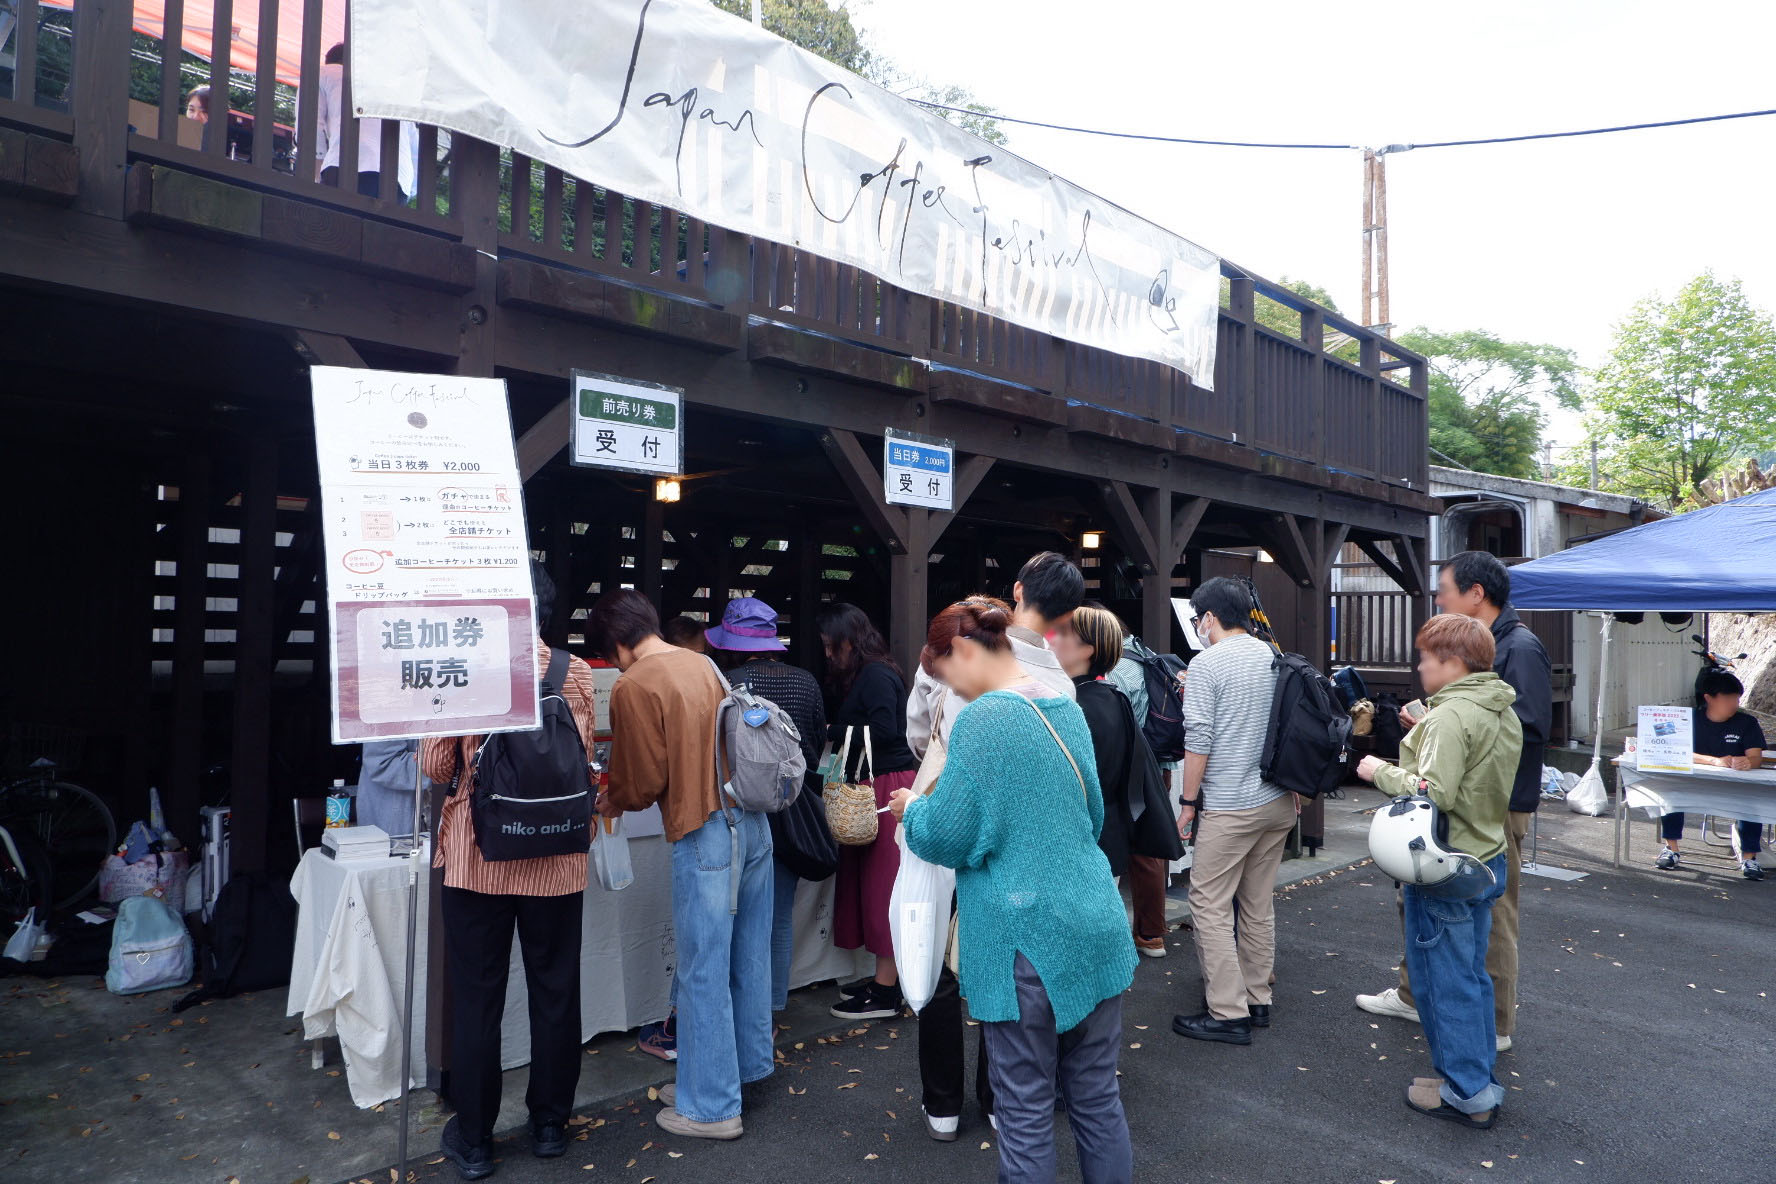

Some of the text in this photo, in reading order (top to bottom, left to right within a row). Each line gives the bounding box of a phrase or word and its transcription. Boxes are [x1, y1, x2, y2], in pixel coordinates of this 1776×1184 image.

[537, 0, 1120, 330] Japan Coffee Festival
[602, 397, 657, 420] 前売り券
[595, 429, 661, 460] 受付
[443, 461, 481, 472] ¥2,000
[893, 447, 946, 468] 当日券 2,000円
[899, 472, 942, 497] 受付
[381, 616, 485, 650] 追加券
[401, 657, 469, 691] 販売
[501, 821, 535, 836] niko
[540, 819, 571, 835] and
